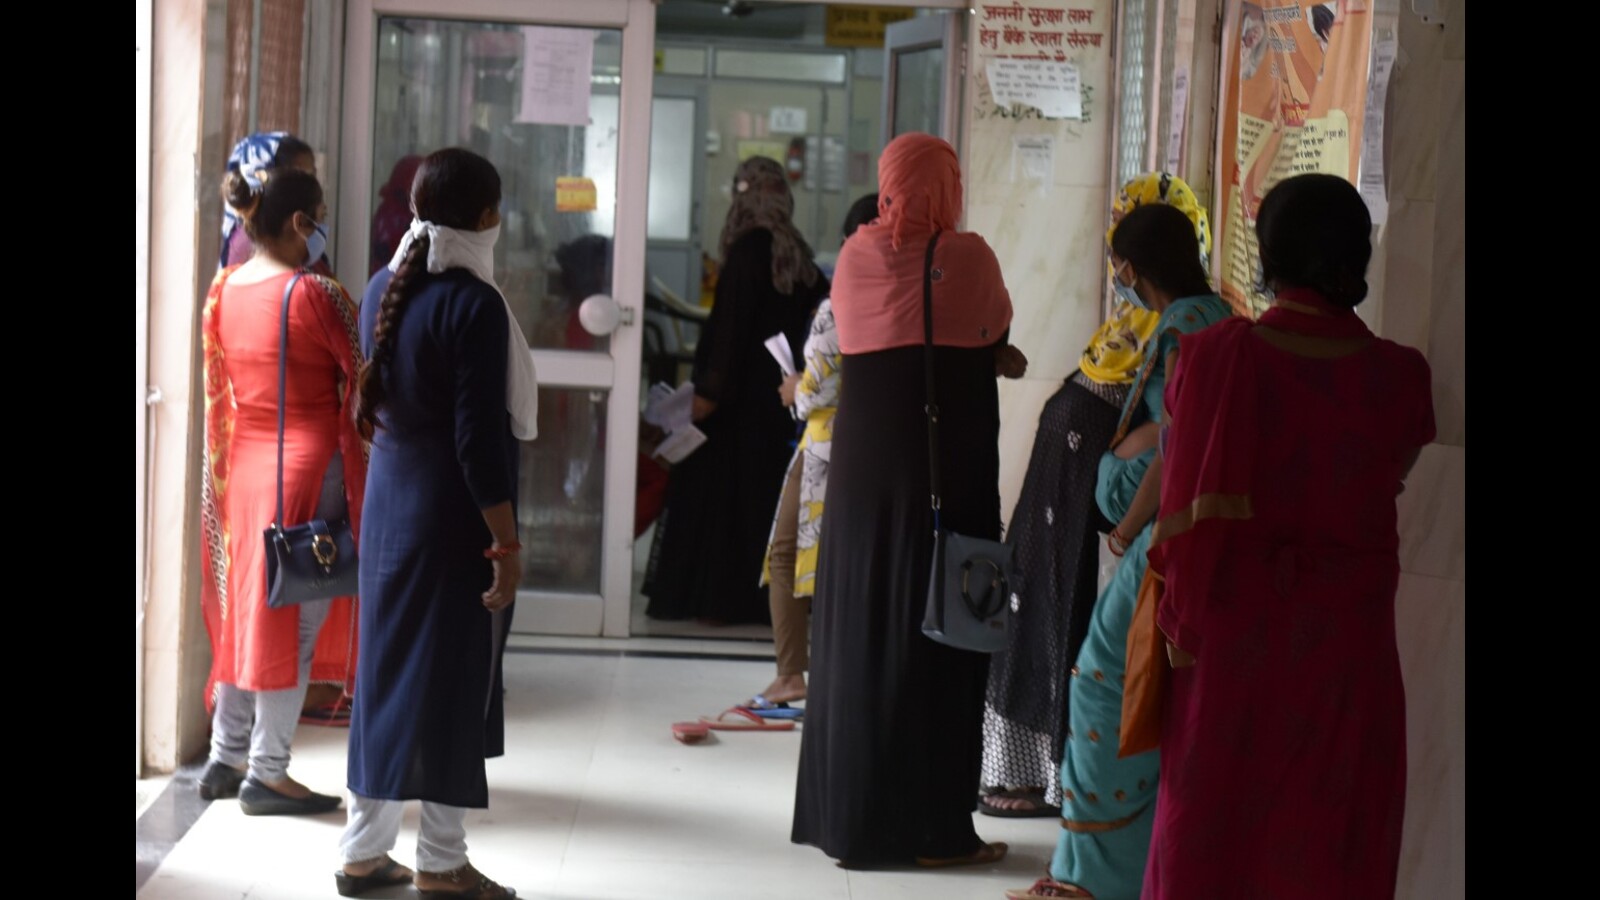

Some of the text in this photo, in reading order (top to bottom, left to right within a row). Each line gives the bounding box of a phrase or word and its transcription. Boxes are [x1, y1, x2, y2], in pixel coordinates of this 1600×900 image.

[982, 1, 1094, 27] जननी सुरक्षा लाभ
[979, 23, 1000, 50] हेतु
[1029, 31, 1064, 47] खाता
